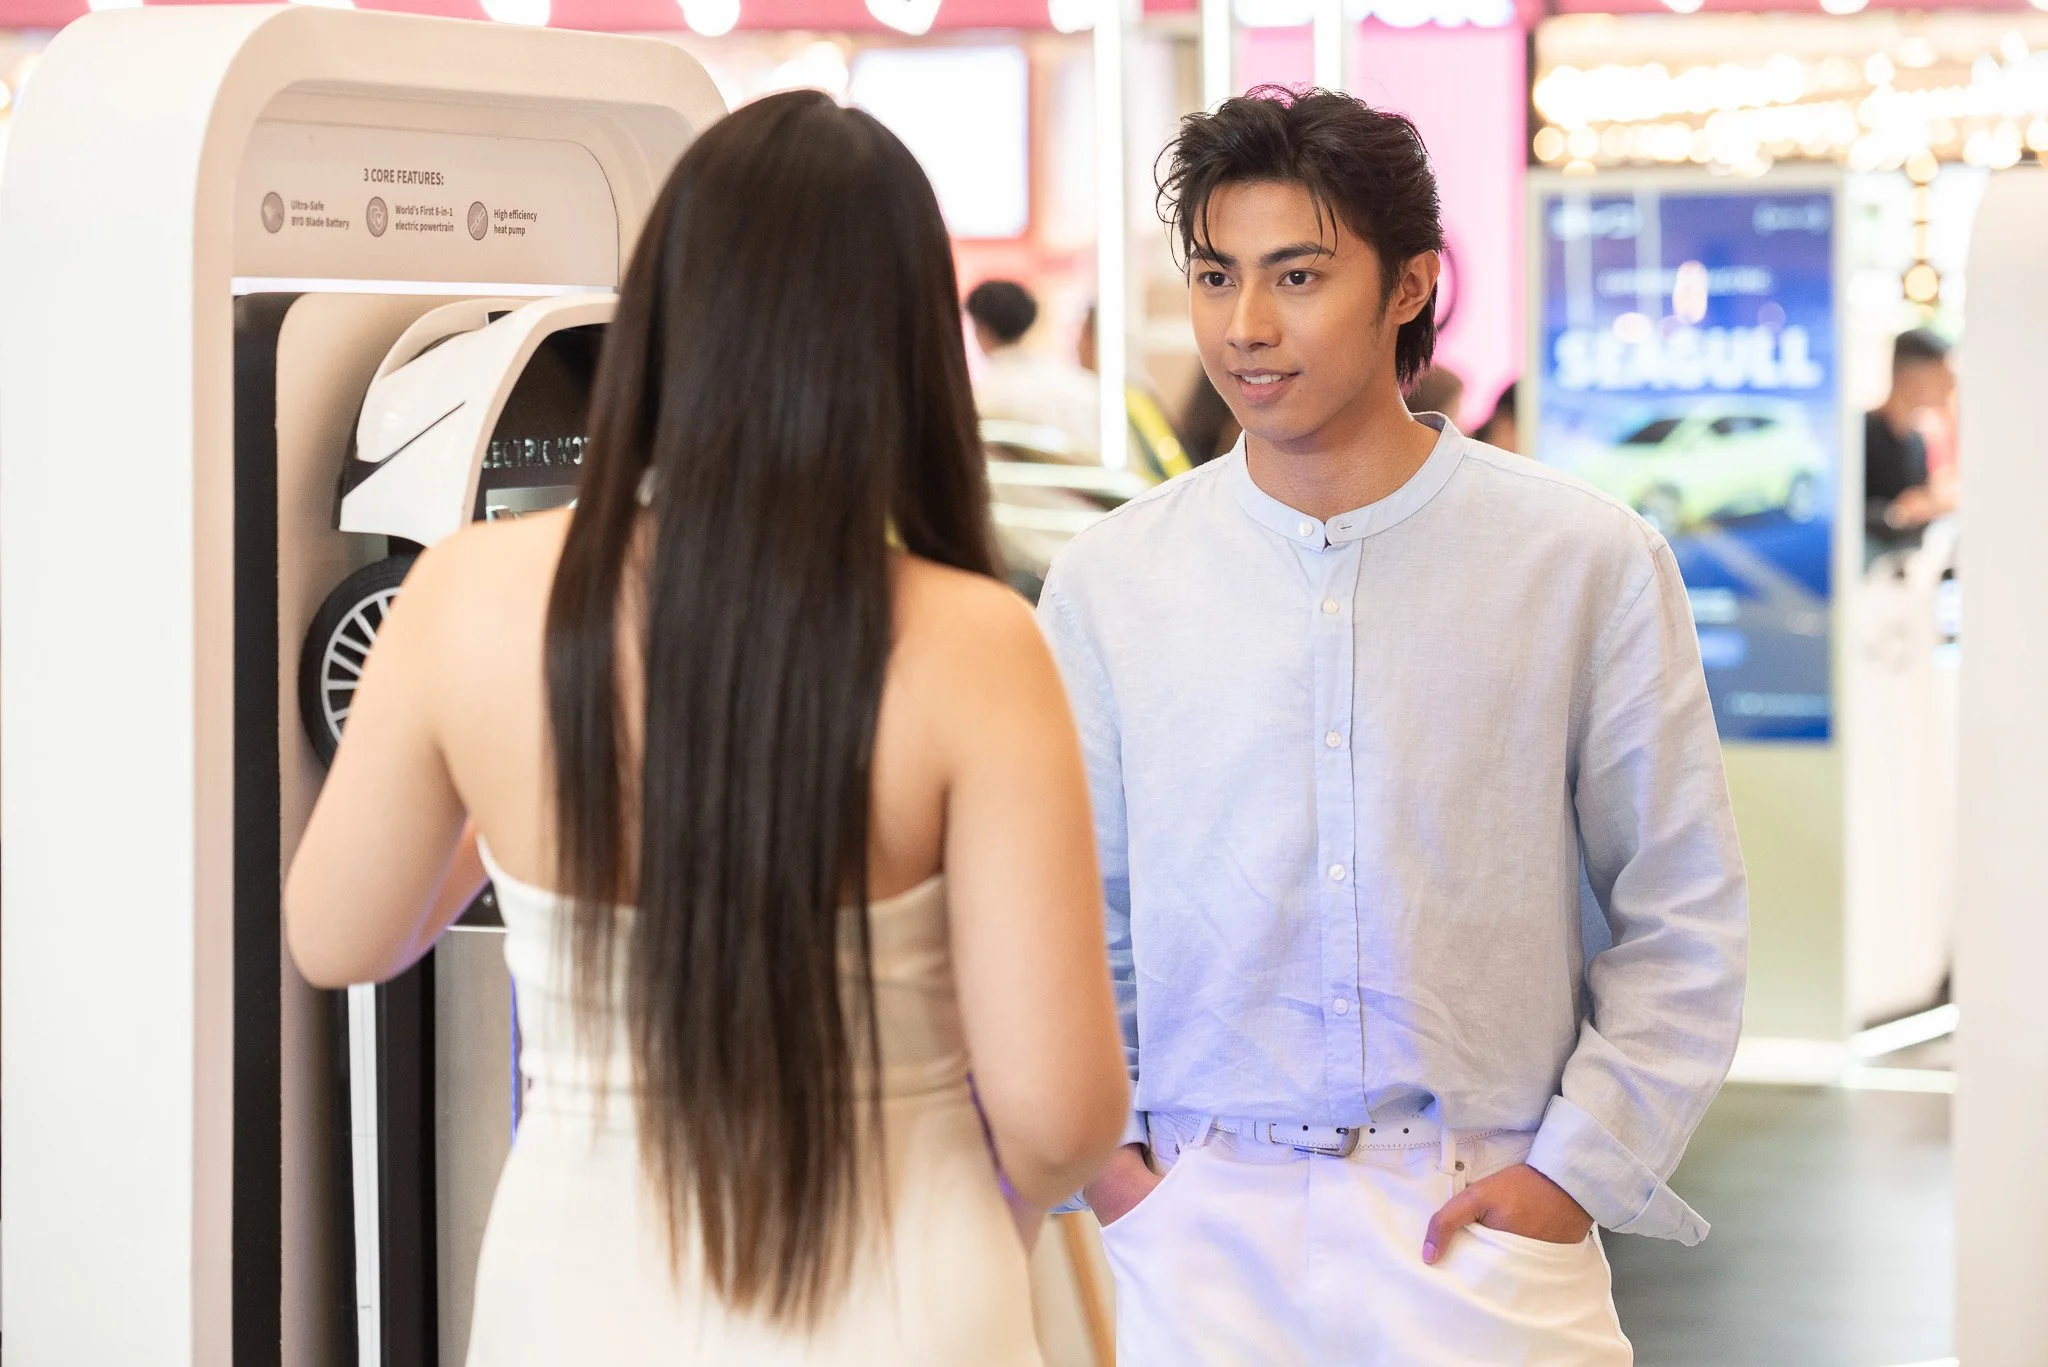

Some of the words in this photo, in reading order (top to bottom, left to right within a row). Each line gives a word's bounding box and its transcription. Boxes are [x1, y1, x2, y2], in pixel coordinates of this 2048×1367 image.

[363, 168, 369, 182] 3
[371, 169, 395, 183] CORE
[397, 170, 444, 185] FEATURES:
[291, 200, 325, 211] Ultra-Safe
[395, 205, 419, 216] World's
[420, 206, 435, 216] First
[494, 209, 508, 222] High
[509, 210, 538, 222] efficiency
[291, 216, 304, 226] BYD
[306, 217, 324, 227] Blade
[326, 218, 350, 230] Battery
[395, 221, 419, 231] electric
[420, 222, 454, 233] powertrain
[494, 224, 508, 234] heat
[509, 227, 526, 236] pump
